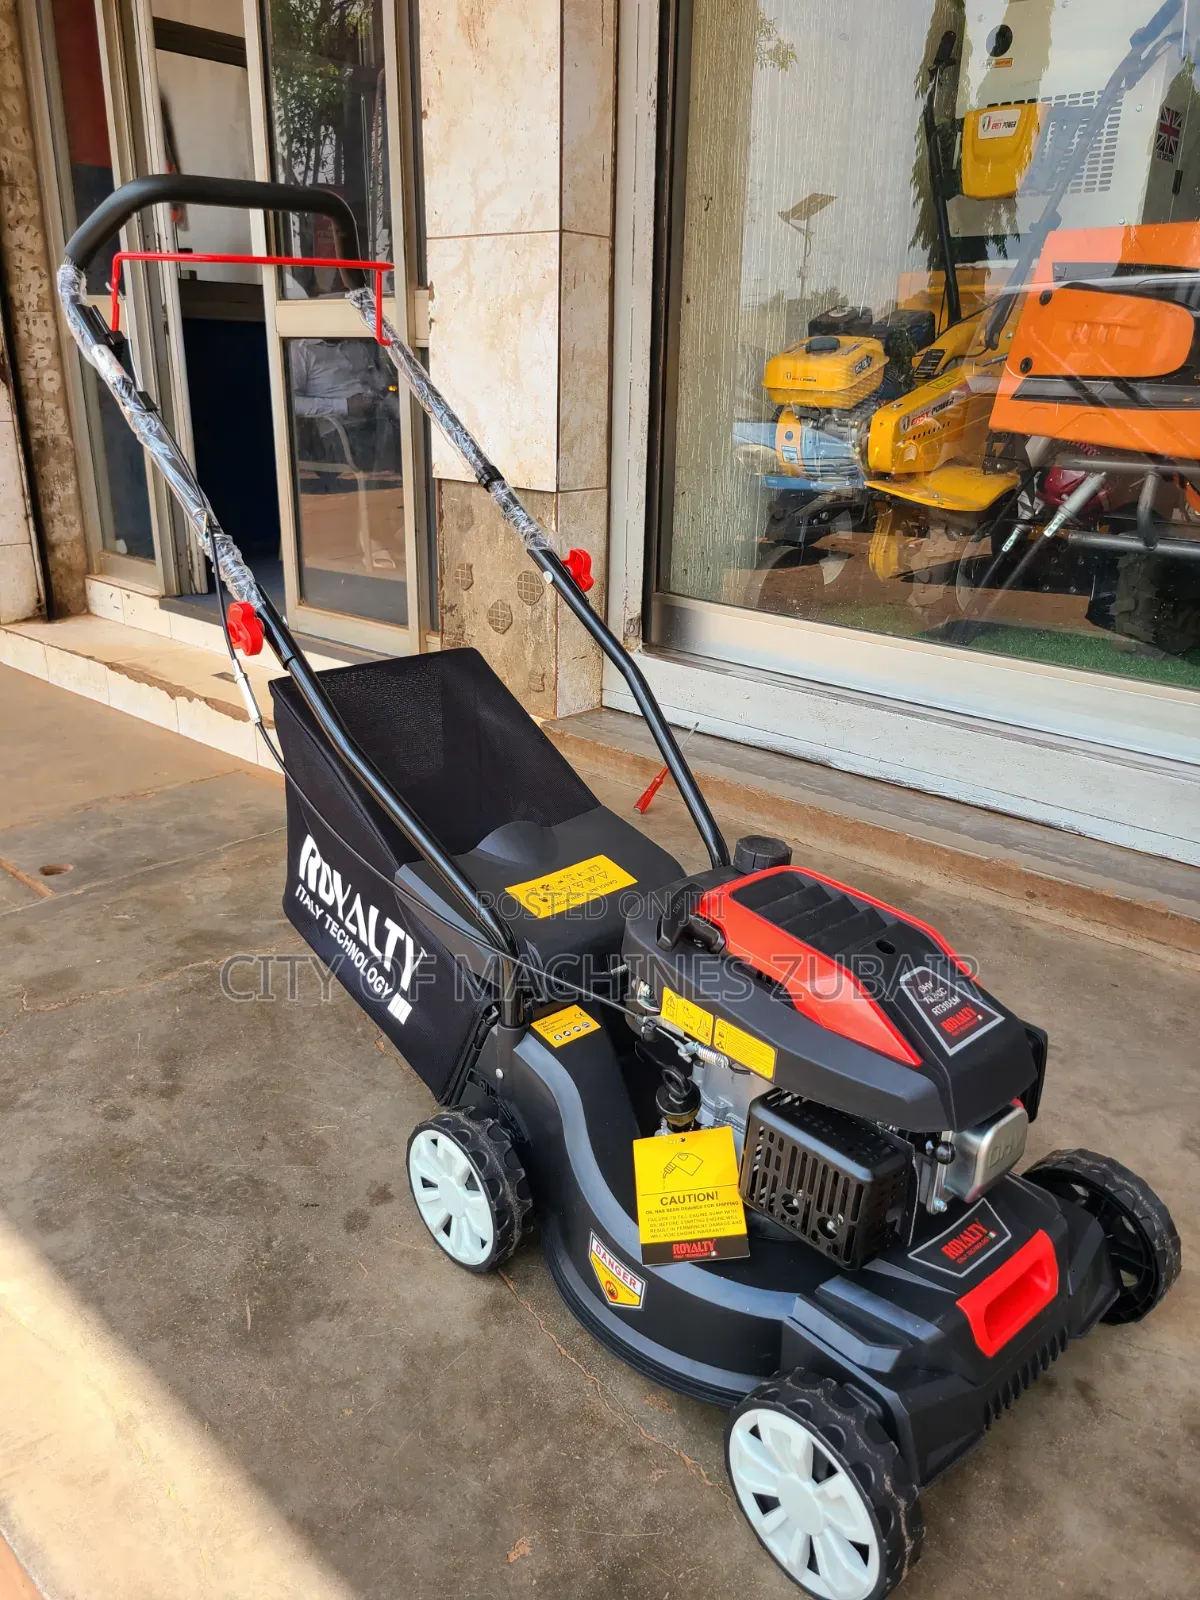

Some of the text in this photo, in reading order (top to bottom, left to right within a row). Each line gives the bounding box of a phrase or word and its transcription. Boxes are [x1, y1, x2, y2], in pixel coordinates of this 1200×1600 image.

[1002, 120, 1017, 129] POWER
[931, 397, 955, 416] POWER
[298, 833, 425, 992] ROYALTY
[295, 883, 393, 1000] ITALY TECHNOLOGY
[917, 980, 934, 993] OHV
[940, 1006, 978, 1033] ROYALTY
[660, 1191, 719, 1206] CAUTION!
[672, 1241, 715, 1254] ROYALTY
[941, 1223, 989, 1261] ROYALTY
[595, 1244, 637, 1290] DANGER
